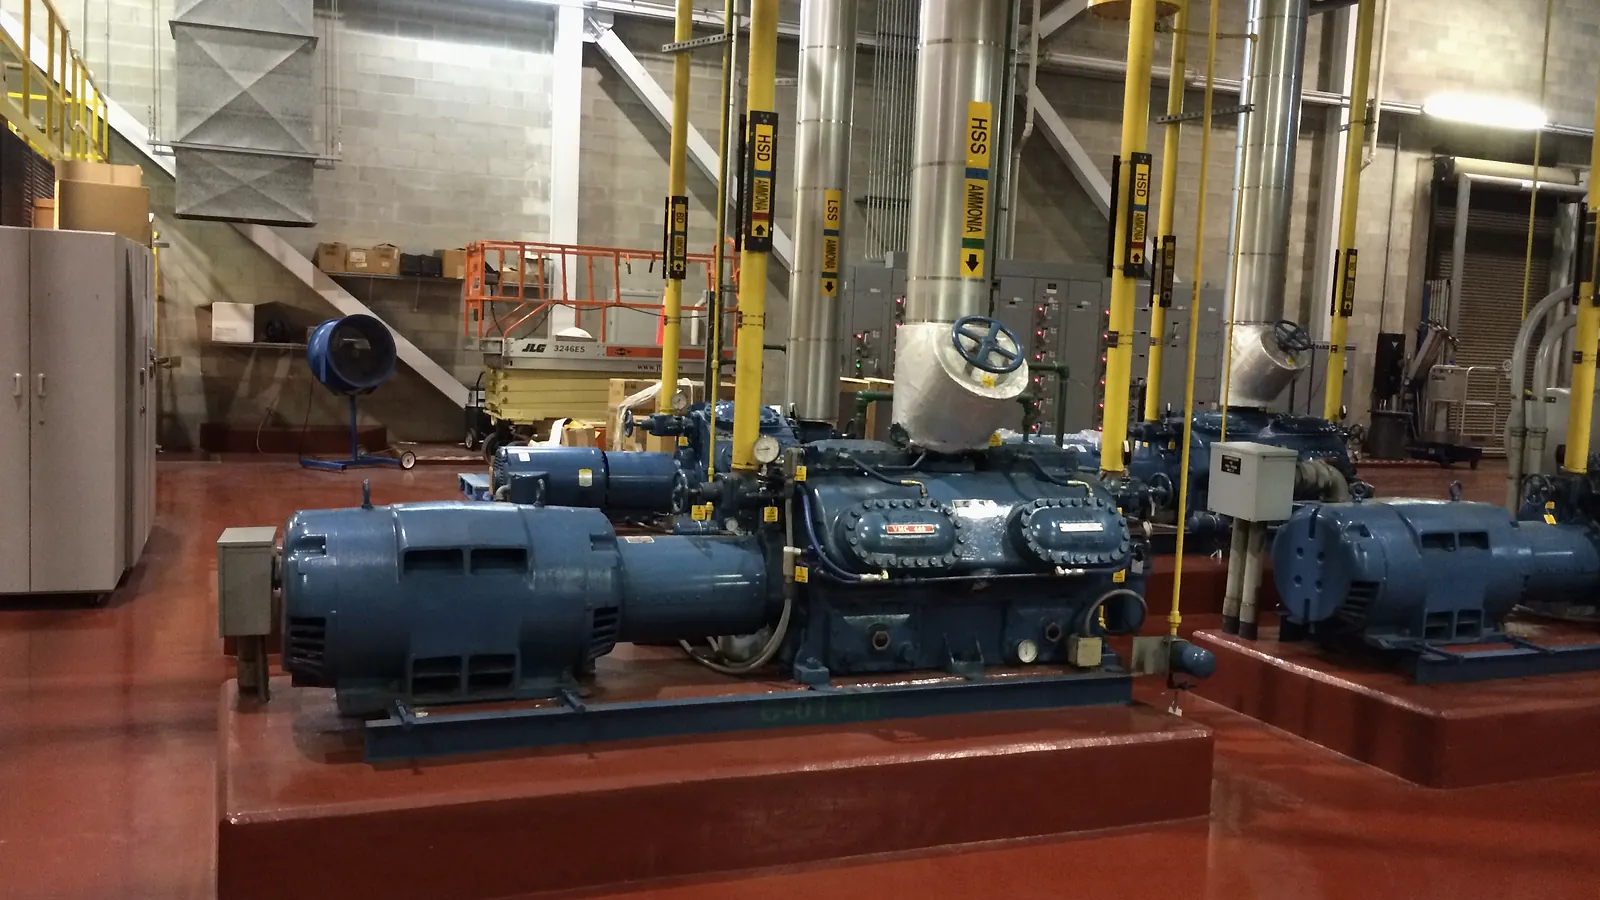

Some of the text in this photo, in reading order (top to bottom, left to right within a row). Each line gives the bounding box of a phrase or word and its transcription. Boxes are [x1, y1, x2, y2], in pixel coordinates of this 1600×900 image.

[755, 134, 771, 211] HSD AMMONIA
[966, 117, 988, 234] HSS AMMONIA
[1136, 172, 1147, 197] HSD
[827, 199, 839, 221] LSS
[522, 343, 586, 353] JLG 3246ES
